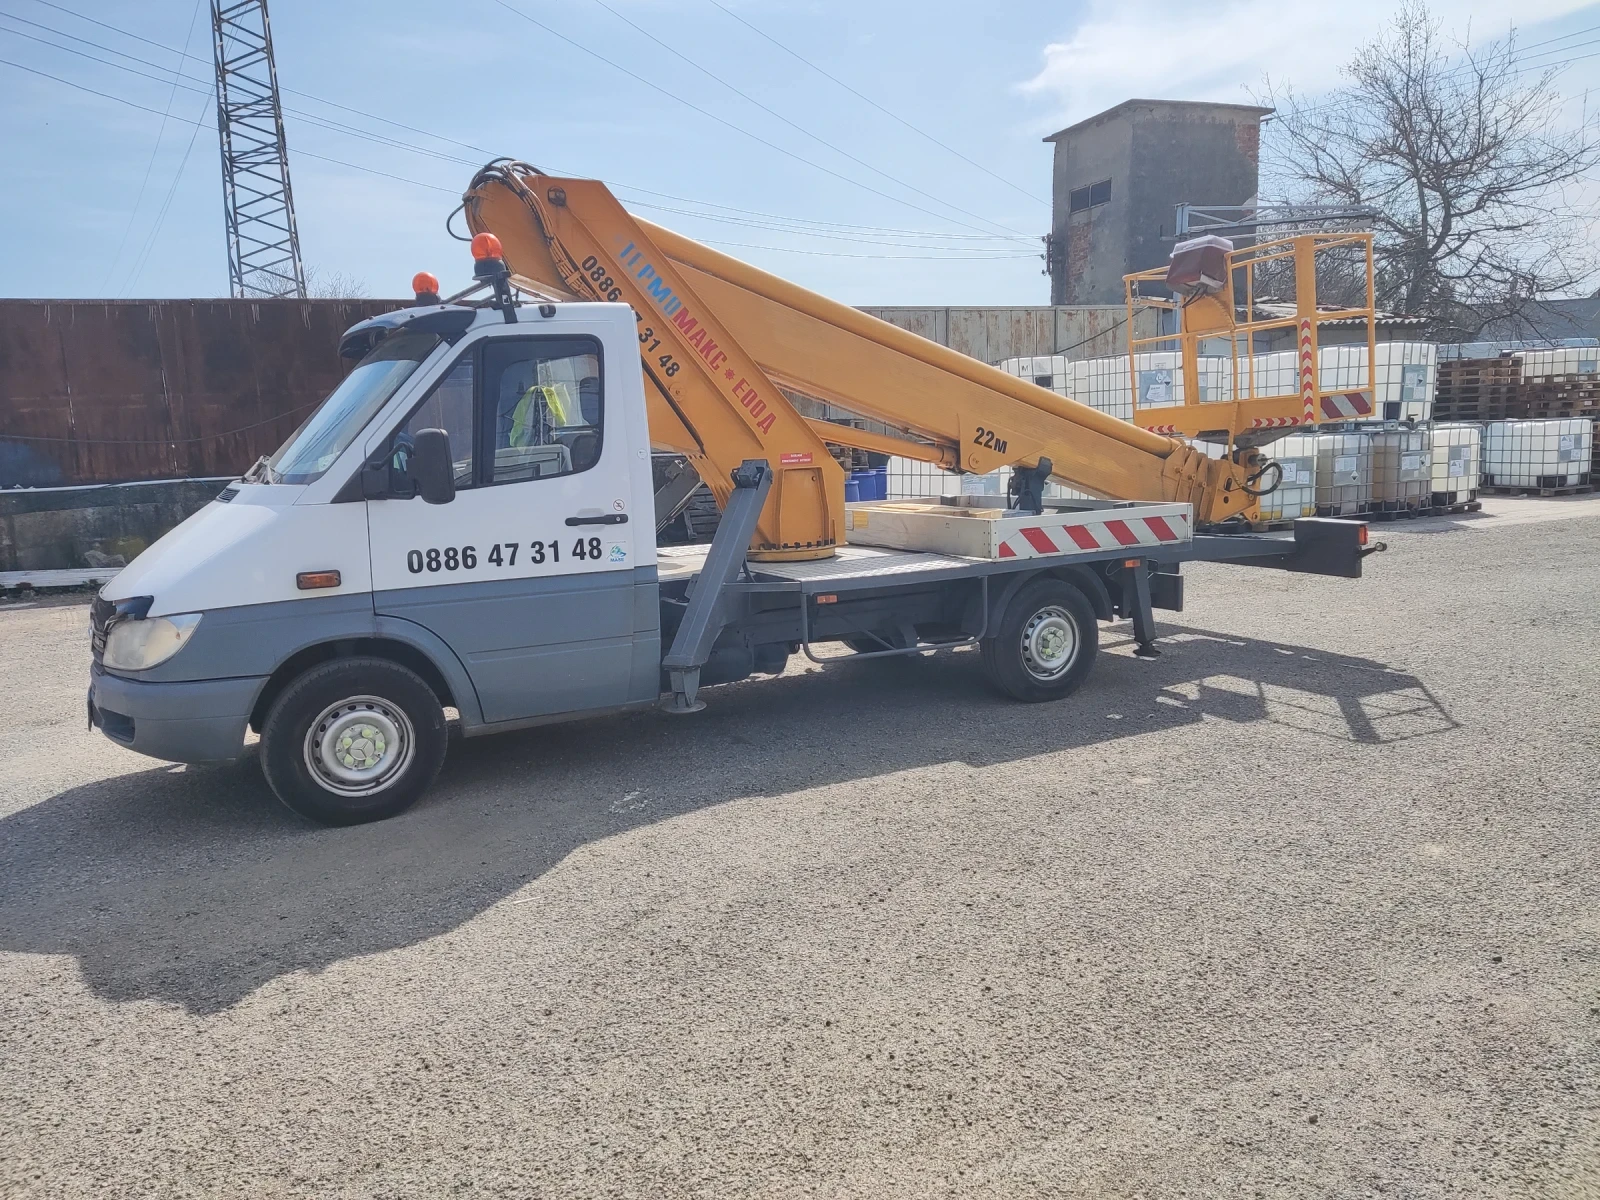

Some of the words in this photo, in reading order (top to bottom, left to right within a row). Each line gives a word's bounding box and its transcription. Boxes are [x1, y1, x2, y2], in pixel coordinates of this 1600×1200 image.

[581, 255, 622, 302] 0886
[638, 327, 661, 353] 31
[658, 354, 681, 378] 48
[406, 545, 478, 574] 0886
[487, 542, 520, 567] 47
[530, 540, 560, 565] 31
[571, 536, 603, 561] 48
